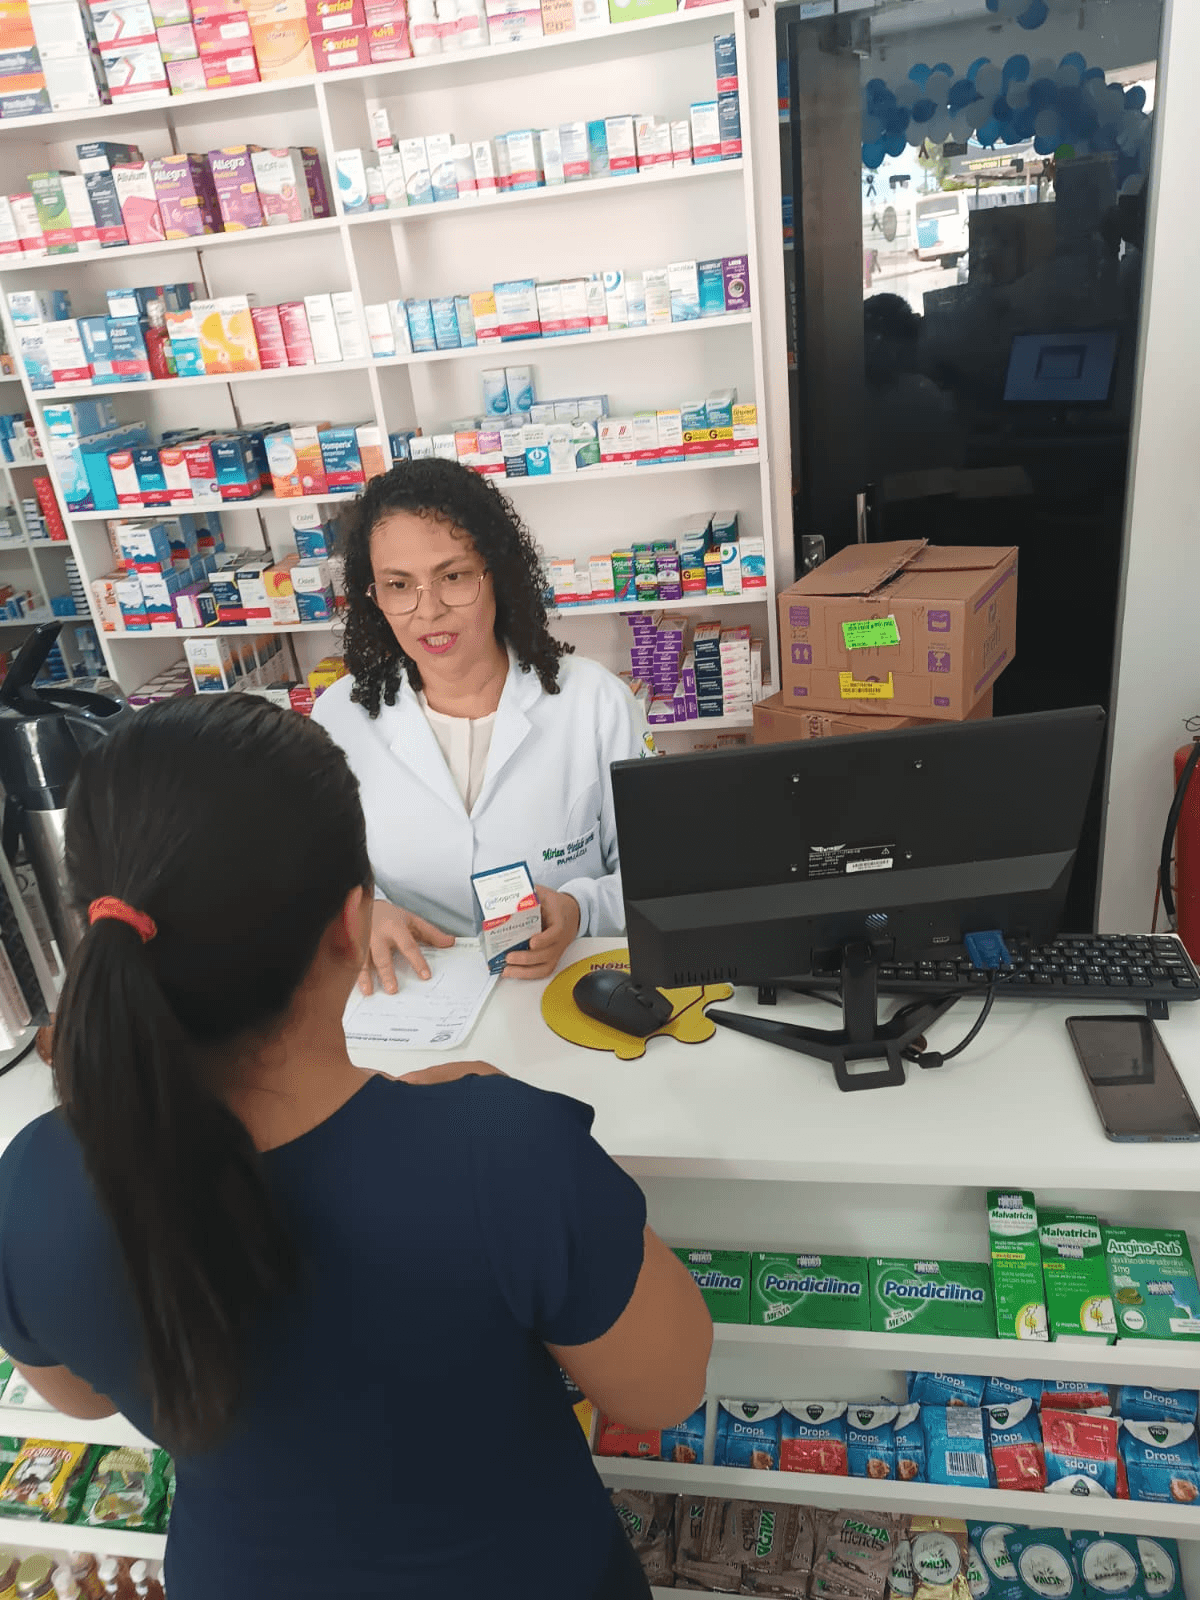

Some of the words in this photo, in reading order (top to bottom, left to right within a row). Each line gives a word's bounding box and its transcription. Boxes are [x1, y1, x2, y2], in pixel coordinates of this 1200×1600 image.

[212, 157, 246, 171] Allegra
[154, 169, 187, 182] Allegra
[991, 1211, 1033, 1220] Malvatricin
[1041, 1228, 1098, 1238] Malvatricin
[1107, 1239, 1182, 1257] Angino-Rub
[765, 1276, 860, 1295] Pondicilina
[885, 1281, 984, 1302] Pondicilina
[934, 1372, 965, 1387] Drops
[991, 1376, 1023, 1393] Drops
[1056, 1381, 1088, 1391] Drops
[1143, 1390, 1178, 1406] Drops
[734, 1423, 764, 1437] Drops
[799, 1426, 830, 1437] Drops
[849, 1431, 879, 1442] Drops
[990, 1433, 1022, 1443] Drops
[1145, 1449, 1181, 1461] Drops
[1065, 1458, 1098, 1474] Drops
[845, 1519, 889, 1542] VALDA
